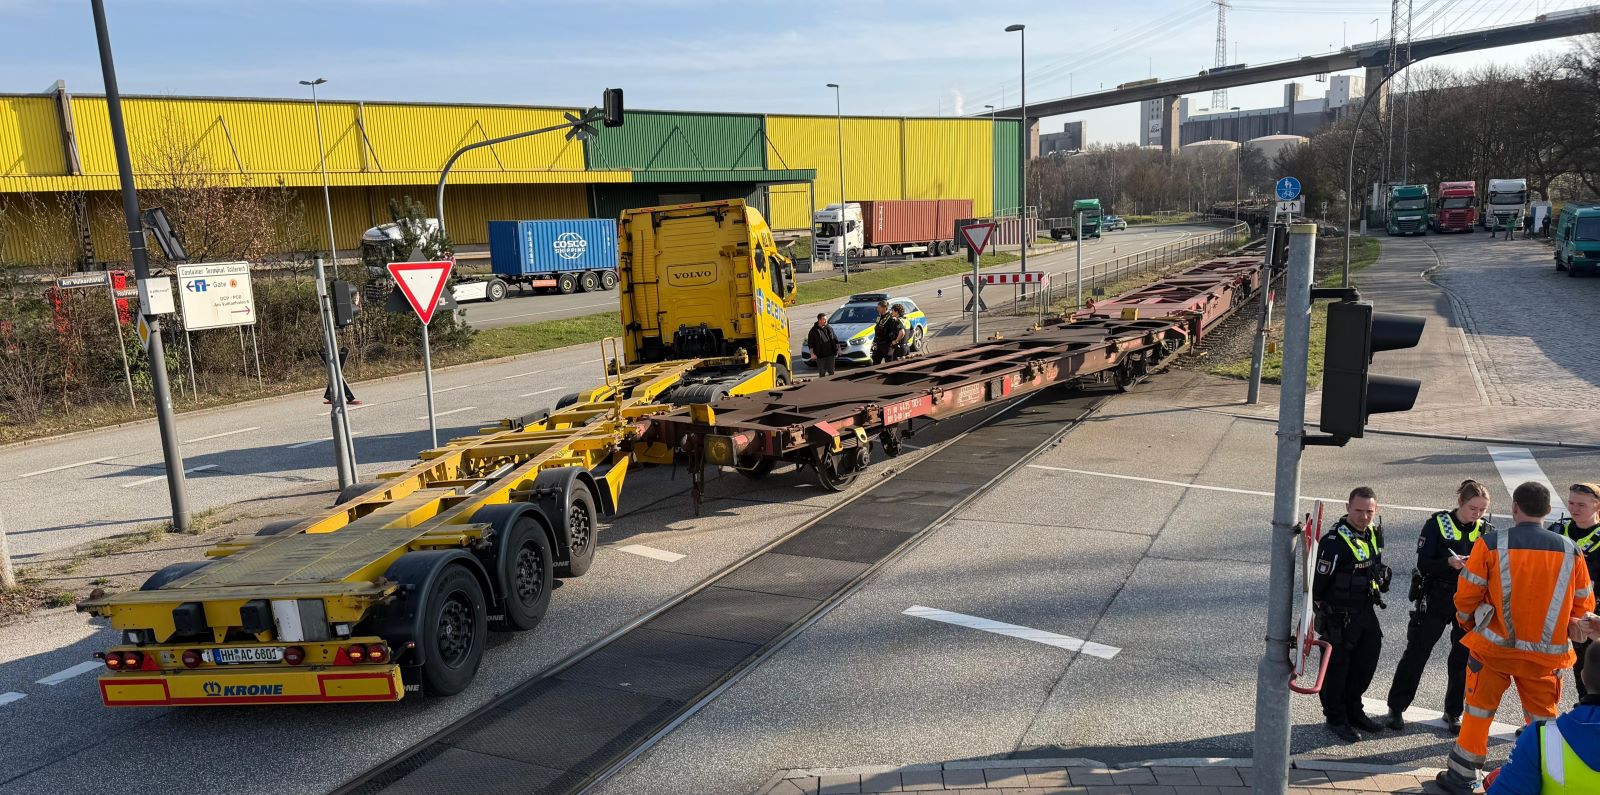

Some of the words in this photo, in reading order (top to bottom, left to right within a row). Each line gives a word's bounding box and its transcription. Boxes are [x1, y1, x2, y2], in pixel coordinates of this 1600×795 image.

[553, 240, 586, 248] COSCO
[673, 271, 711, 279] VOLVO
[221, 649, 234, 660] HH
[241, 649, 253, 660] AC
[255, 648, 277, 660] 6801
[224, 685, 283, 696] KRONE
